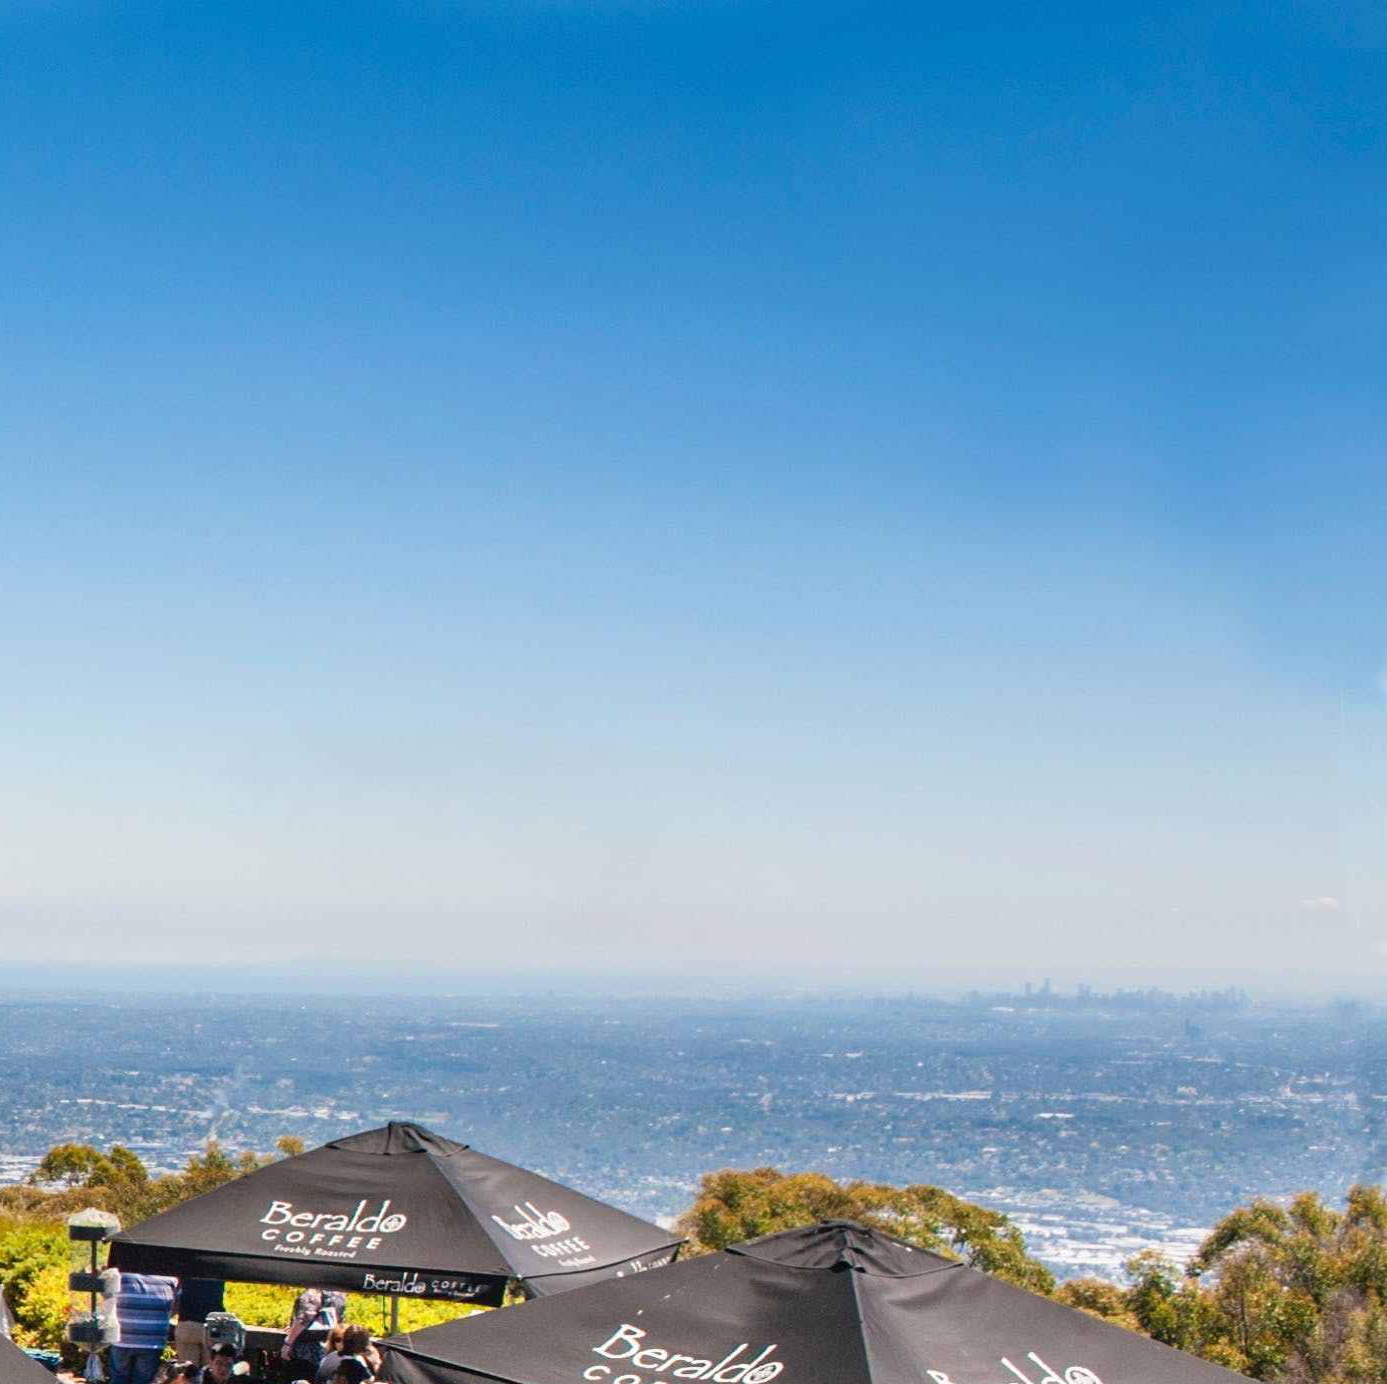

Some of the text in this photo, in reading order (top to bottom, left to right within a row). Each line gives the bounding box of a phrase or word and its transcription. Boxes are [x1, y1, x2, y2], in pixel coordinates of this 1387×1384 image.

[260, 1199, 407, 1233] Beraldo
[261, 1228, 382, 1250] COFFEE
[531, 1236, 590, 1258] COFFEE
[274, 1244, 357, 1259] Freshly Roasted
[363, 1272, 426, 1294] Beraldo
[592, 1323, 784, 1384] Beraldo
